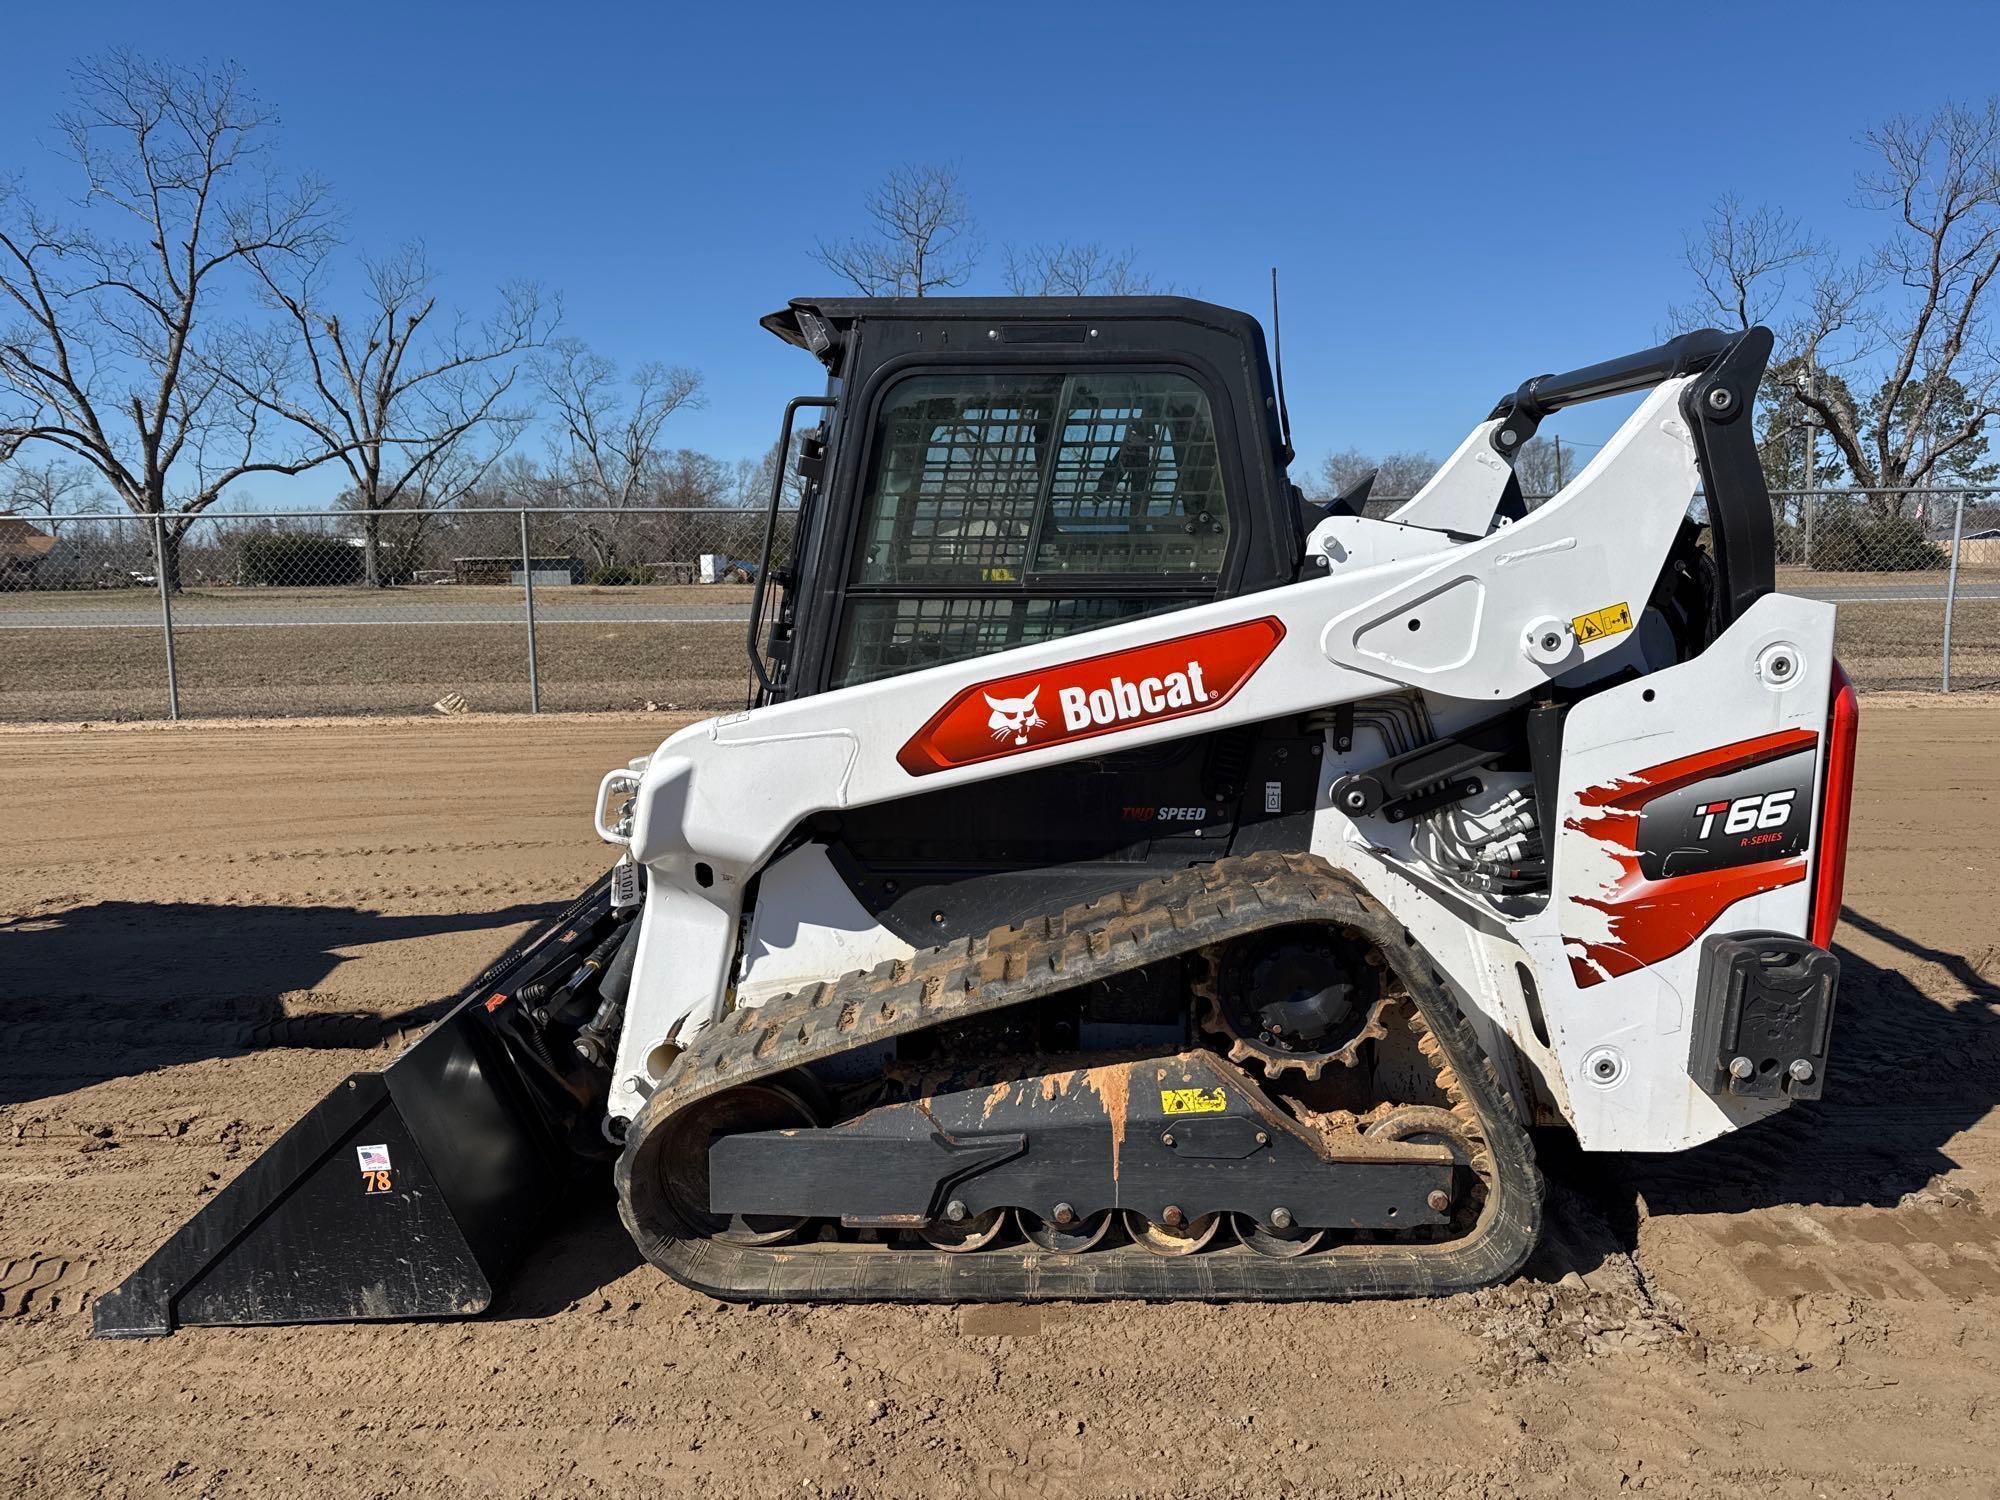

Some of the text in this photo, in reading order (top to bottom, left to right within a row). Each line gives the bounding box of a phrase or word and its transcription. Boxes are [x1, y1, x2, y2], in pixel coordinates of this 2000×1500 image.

[1059, 660, 1208, 731] Bobcat
[1122, 807, 1207, 821] TWO SPEED
[1695, 789, 1797, 840] T66
[1740, 831, 1784, 847] R-SERIES
[622, 862, 634, 900] 211078
[362, 1170, 392, 1192] 78
